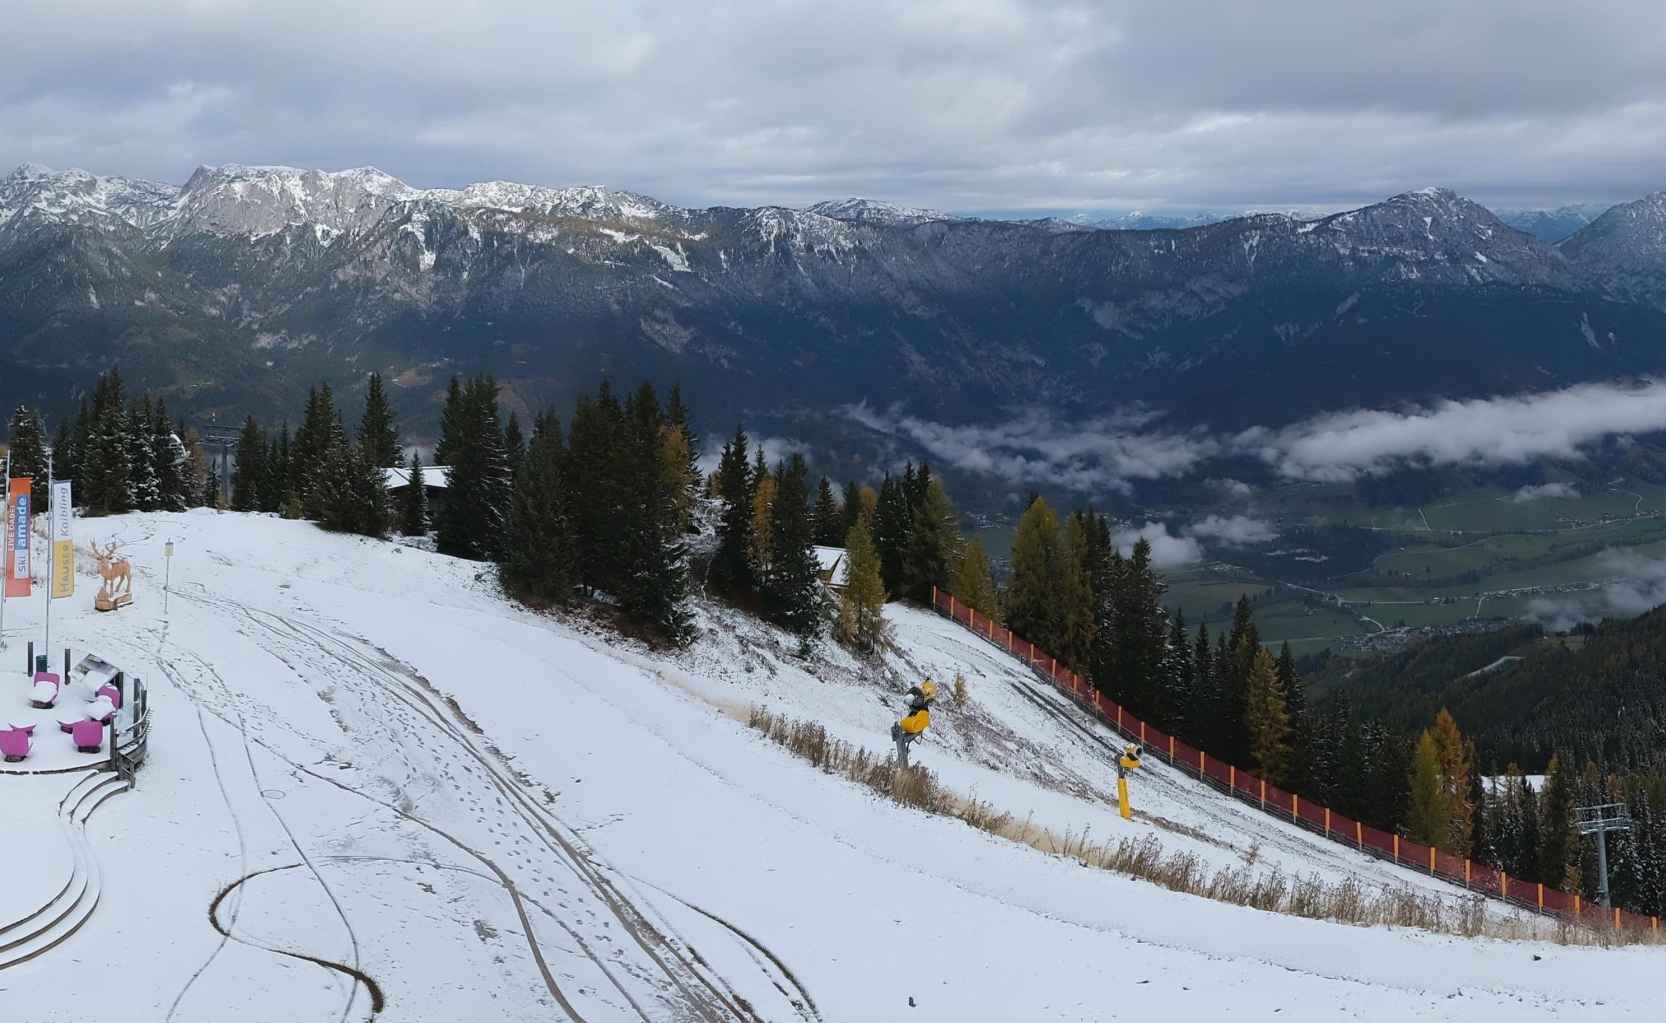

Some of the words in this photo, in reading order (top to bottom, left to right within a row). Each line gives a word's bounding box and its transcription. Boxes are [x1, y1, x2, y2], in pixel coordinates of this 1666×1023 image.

[60, 487, 69, 537] Kaibling
[18, 556, 26, 572] Ski
[60, 545, 70, 593] HAUSER
